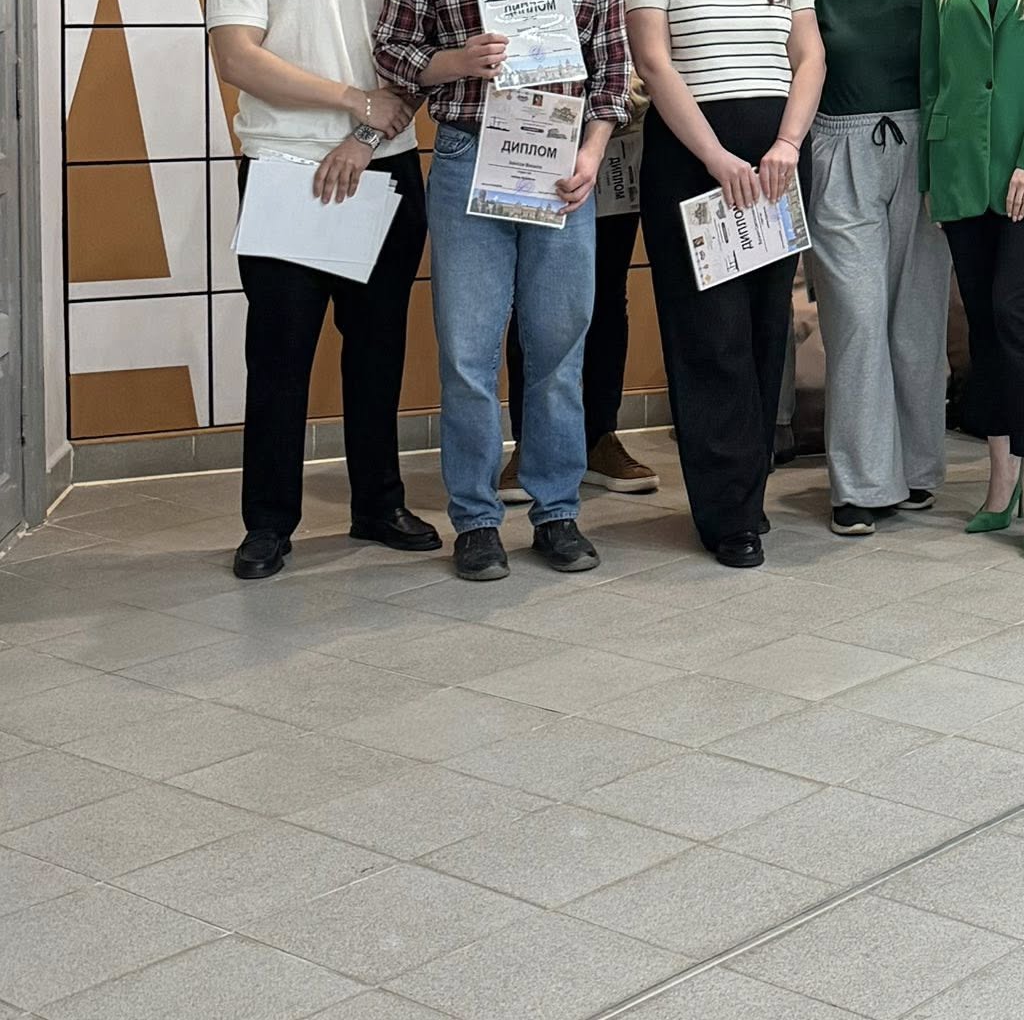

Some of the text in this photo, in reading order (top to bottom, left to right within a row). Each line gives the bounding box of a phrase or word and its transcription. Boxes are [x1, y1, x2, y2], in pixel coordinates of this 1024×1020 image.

[501, 140, 557, 159] ДИПЛОМ
[608, 157, 625, 200] ДИПЛОМ
[732, 204, 754, 251] ДИПЛО
